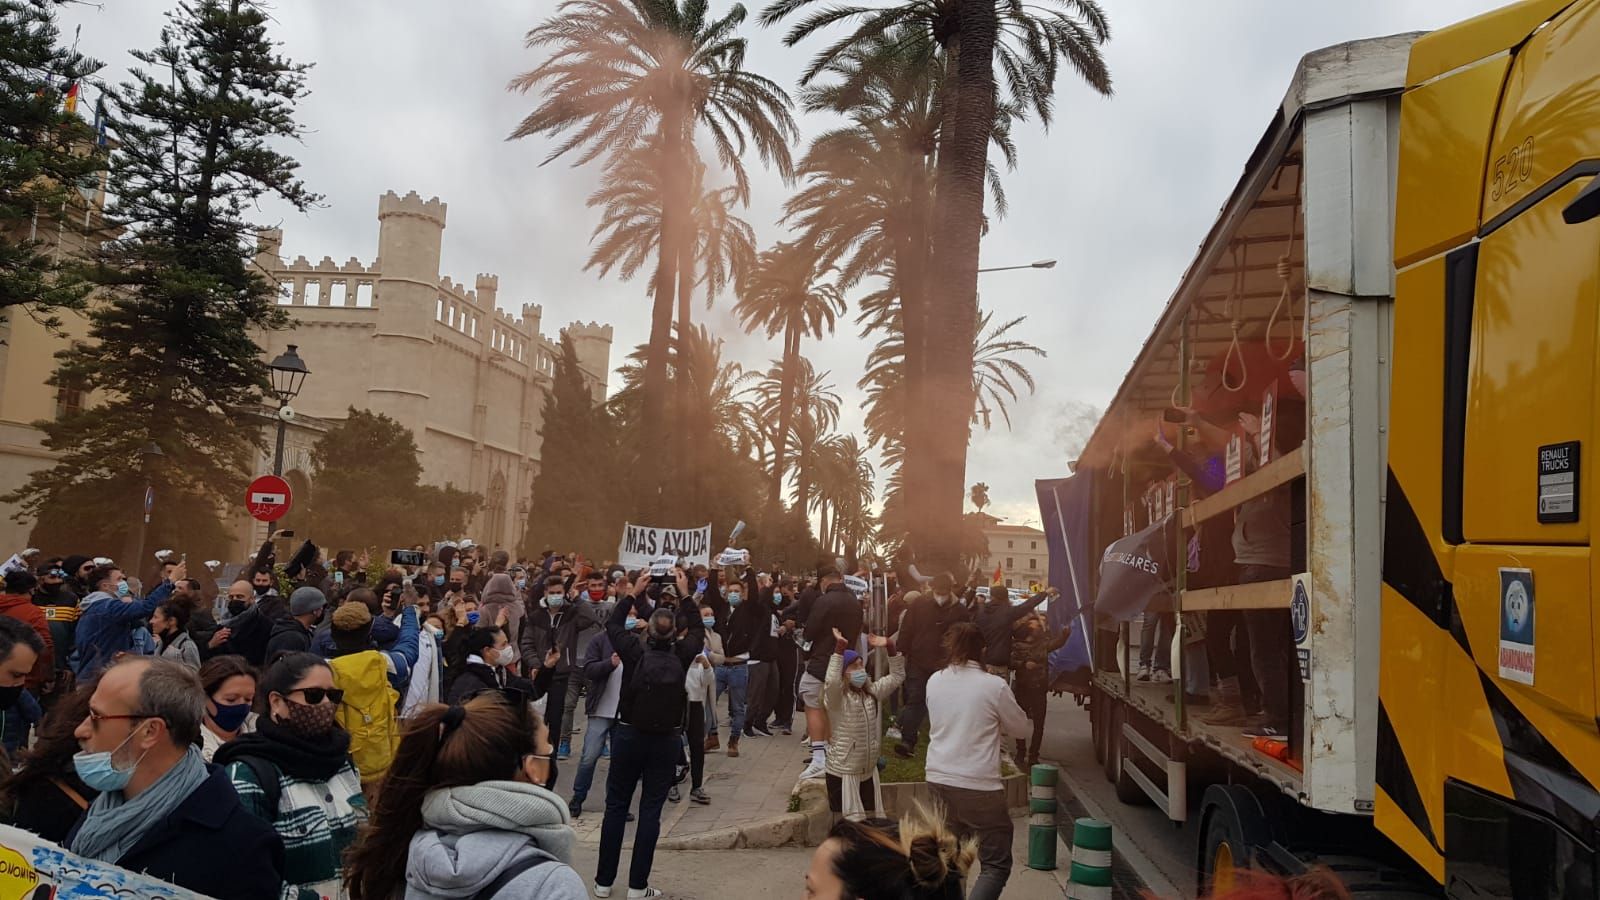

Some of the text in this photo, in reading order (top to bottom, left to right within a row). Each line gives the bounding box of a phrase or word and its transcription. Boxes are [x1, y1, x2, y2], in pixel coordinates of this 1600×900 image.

[1491, 135, 1535, 202] 520
[1541, 447, 1569, 461] RENAULT
[1541, 458, 1570, 472] TRUCKS
[625, 526, 657, 556] MAS
[662, 529, 707, 557] AYUDA
